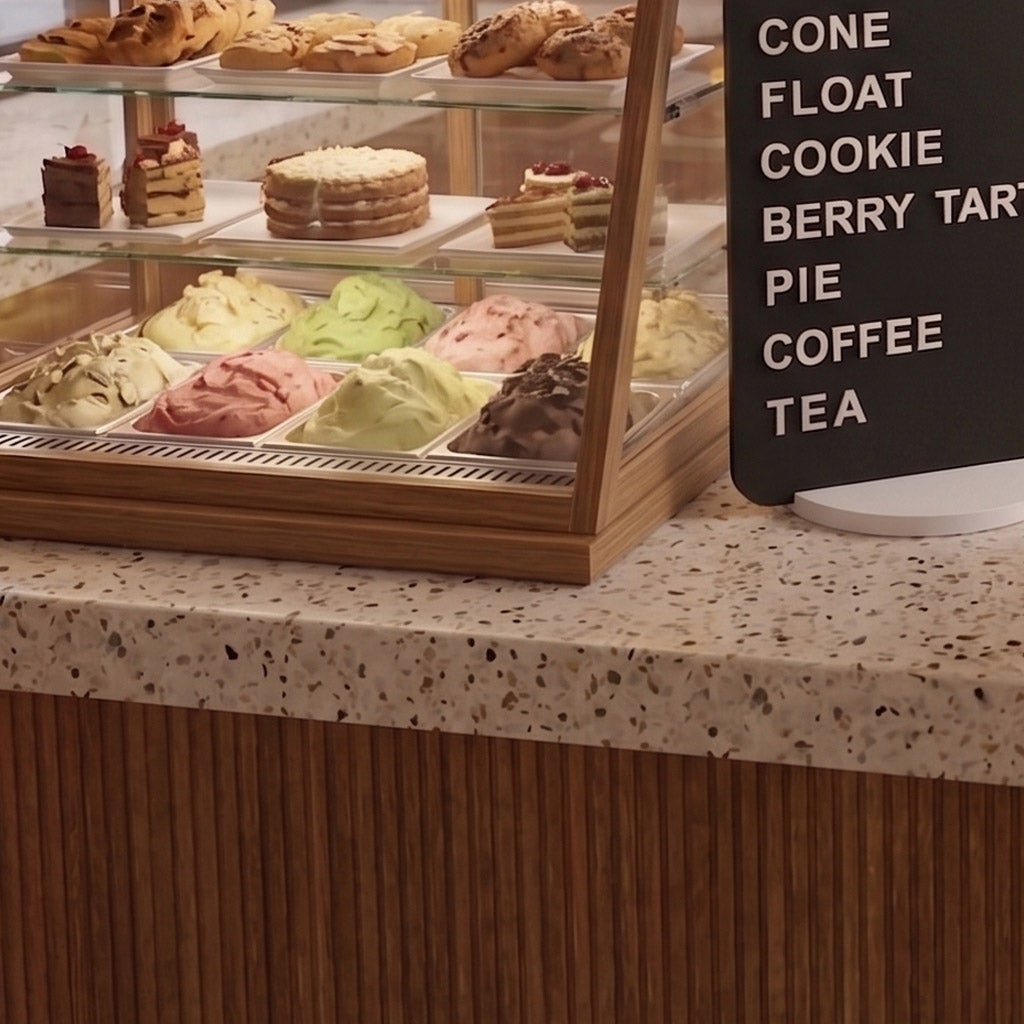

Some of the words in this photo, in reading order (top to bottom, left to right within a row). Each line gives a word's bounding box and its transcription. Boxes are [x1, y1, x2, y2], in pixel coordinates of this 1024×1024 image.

[758, 11, 890, 56] CONE
[761, 71, 912, 119] FLOAT
[760, 129, 943, 180] COOKIE
[763, 192, 915, 243] BERRY
[766, 263, 842, 307] PIE
[763, 313, 943, 370] COFFEE
[766, 388, 867, 436] TEA
